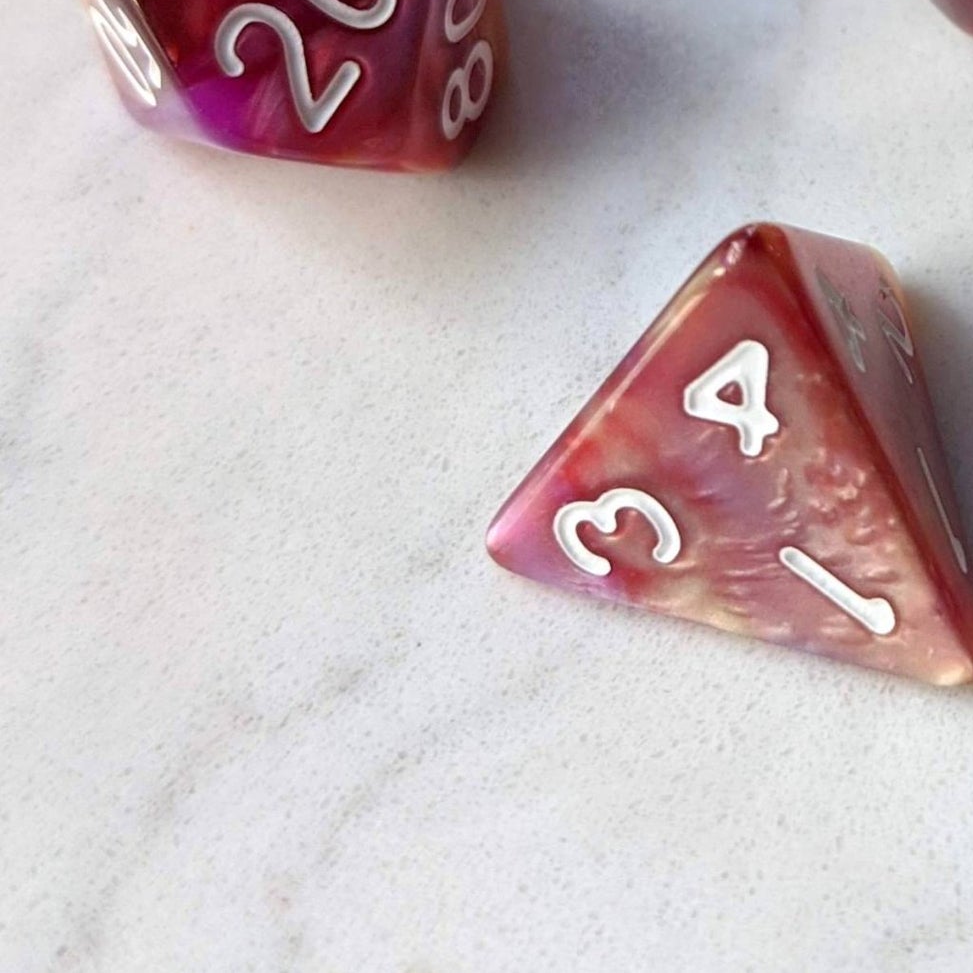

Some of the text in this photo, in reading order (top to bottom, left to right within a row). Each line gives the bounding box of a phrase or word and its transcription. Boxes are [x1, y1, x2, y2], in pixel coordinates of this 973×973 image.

[684, 339, 780, 457] 4
[553, 487, 682, 577] 3
[779, 547, 896, 636] 1
